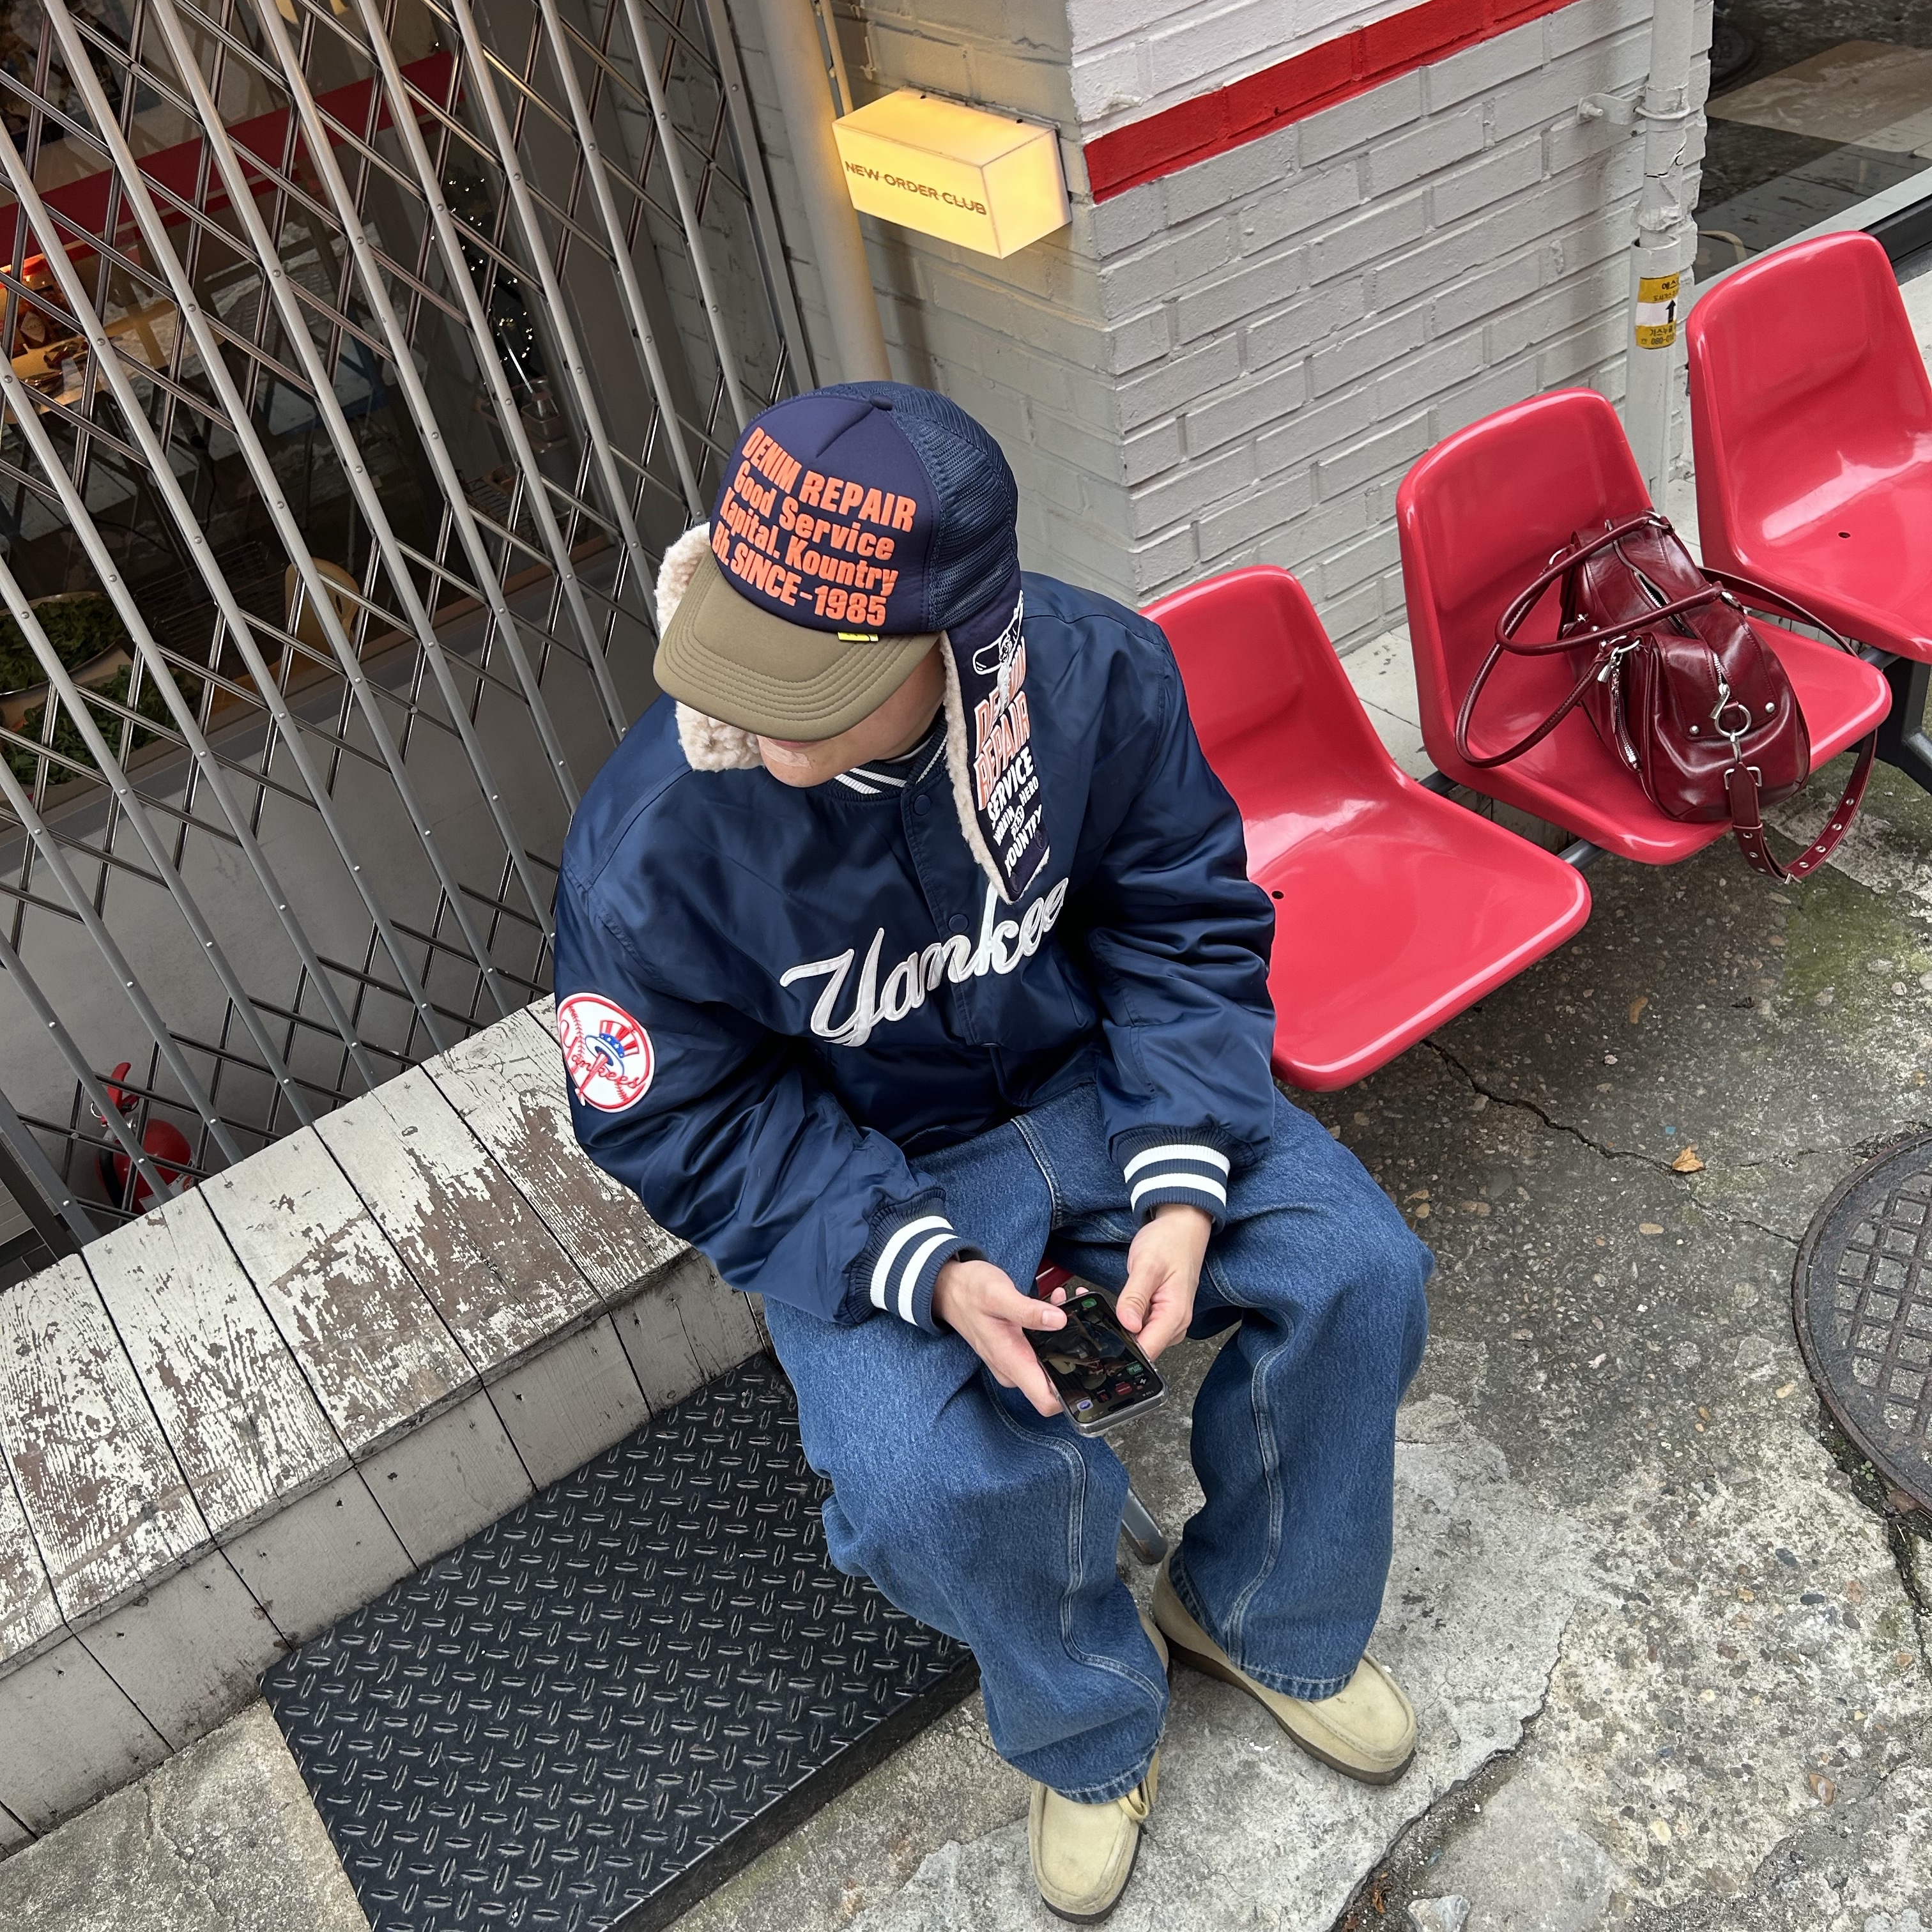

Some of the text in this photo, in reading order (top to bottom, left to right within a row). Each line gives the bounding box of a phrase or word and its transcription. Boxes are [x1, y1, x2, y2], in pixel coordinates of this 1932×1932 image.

[844, 161, 987, 215] NEW ORDER CLUB
[733, 459, 895, 561] Good Service
[742, 426, 917, 533] DENIM REPAIR
[720, 486, 899, 597] Kapital. Kountry
[973, 690, 1031, 811] REPAIR
[987, 746, 1034, 831] SERVICE
[1018, 776, 1039, 807] HERO
